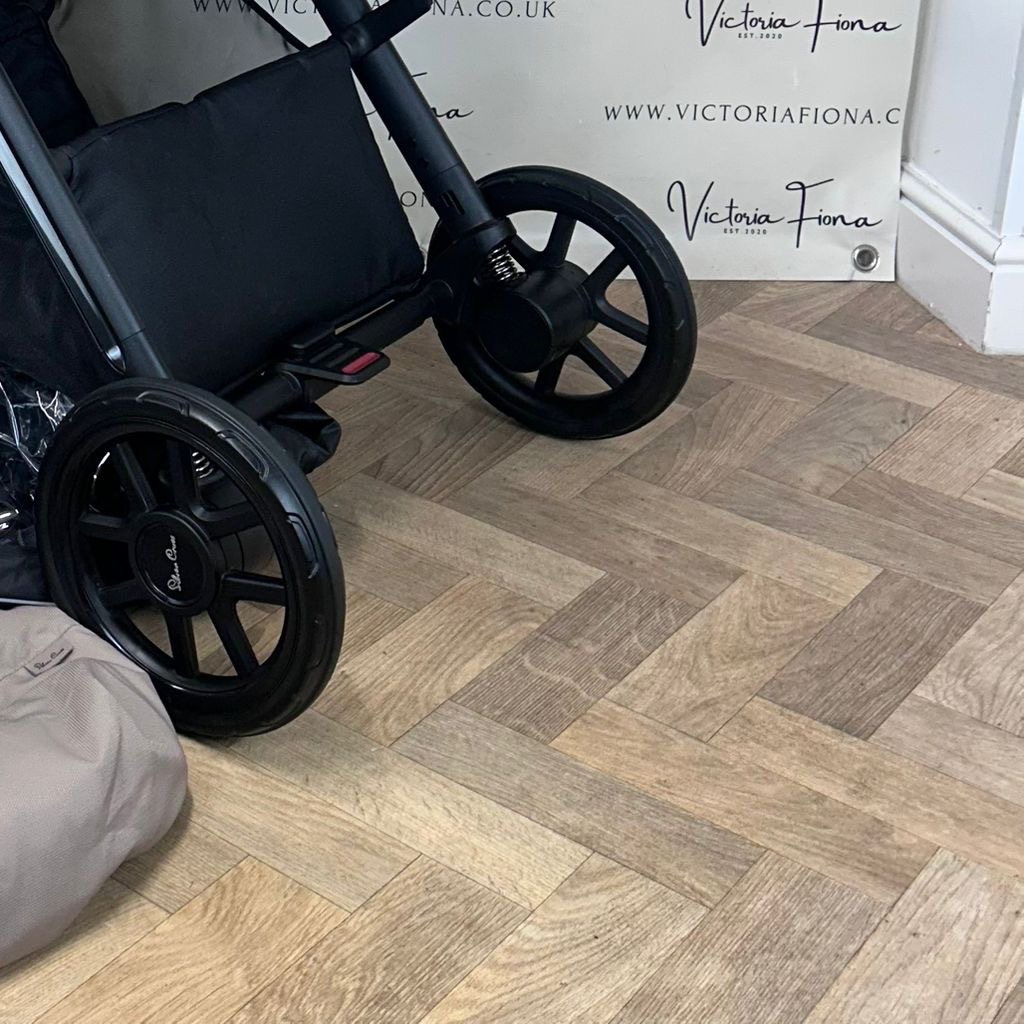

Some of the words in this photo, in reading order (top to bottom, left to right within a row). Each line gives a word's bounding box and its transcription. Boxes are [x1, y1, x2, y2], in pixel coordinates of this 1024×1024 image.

[604, 103, 901, 125] WWW.VICTORIAFIONA.C
[667, 180, 785, 241] Victoria
[785, 178, 883, 248] Fiona
